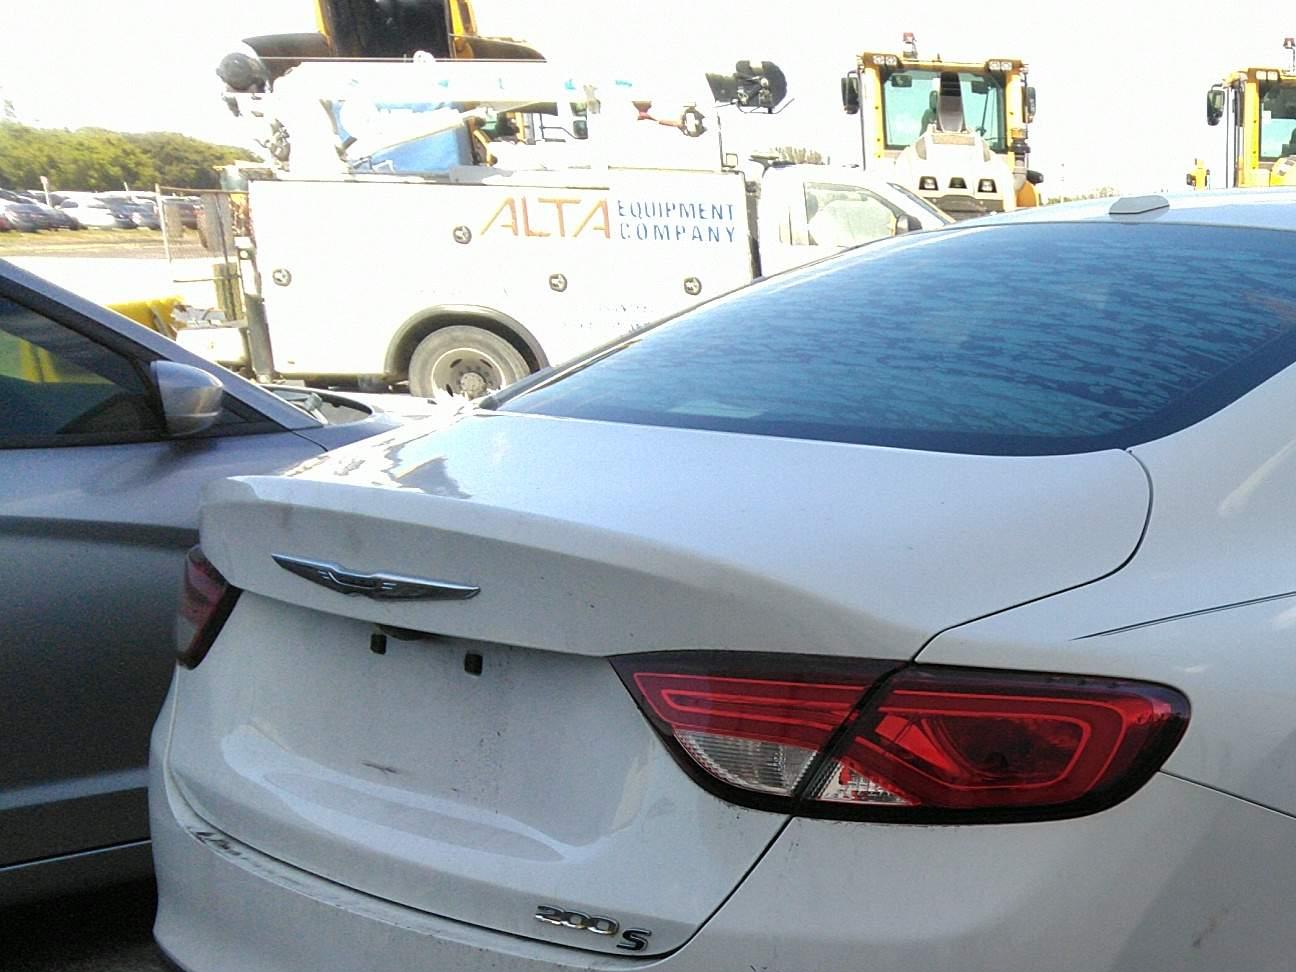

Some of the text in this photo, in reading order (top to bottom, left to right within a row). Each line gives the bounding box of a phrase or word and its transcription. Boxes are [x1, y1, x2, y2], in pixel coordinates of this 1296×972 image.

[480, 195, 611, 239] ALTA
[617, 200, 736, 221] EQUIPMENT
[619, 222, 736, 243] COMPANY
[616, 927, 653, 952] S
